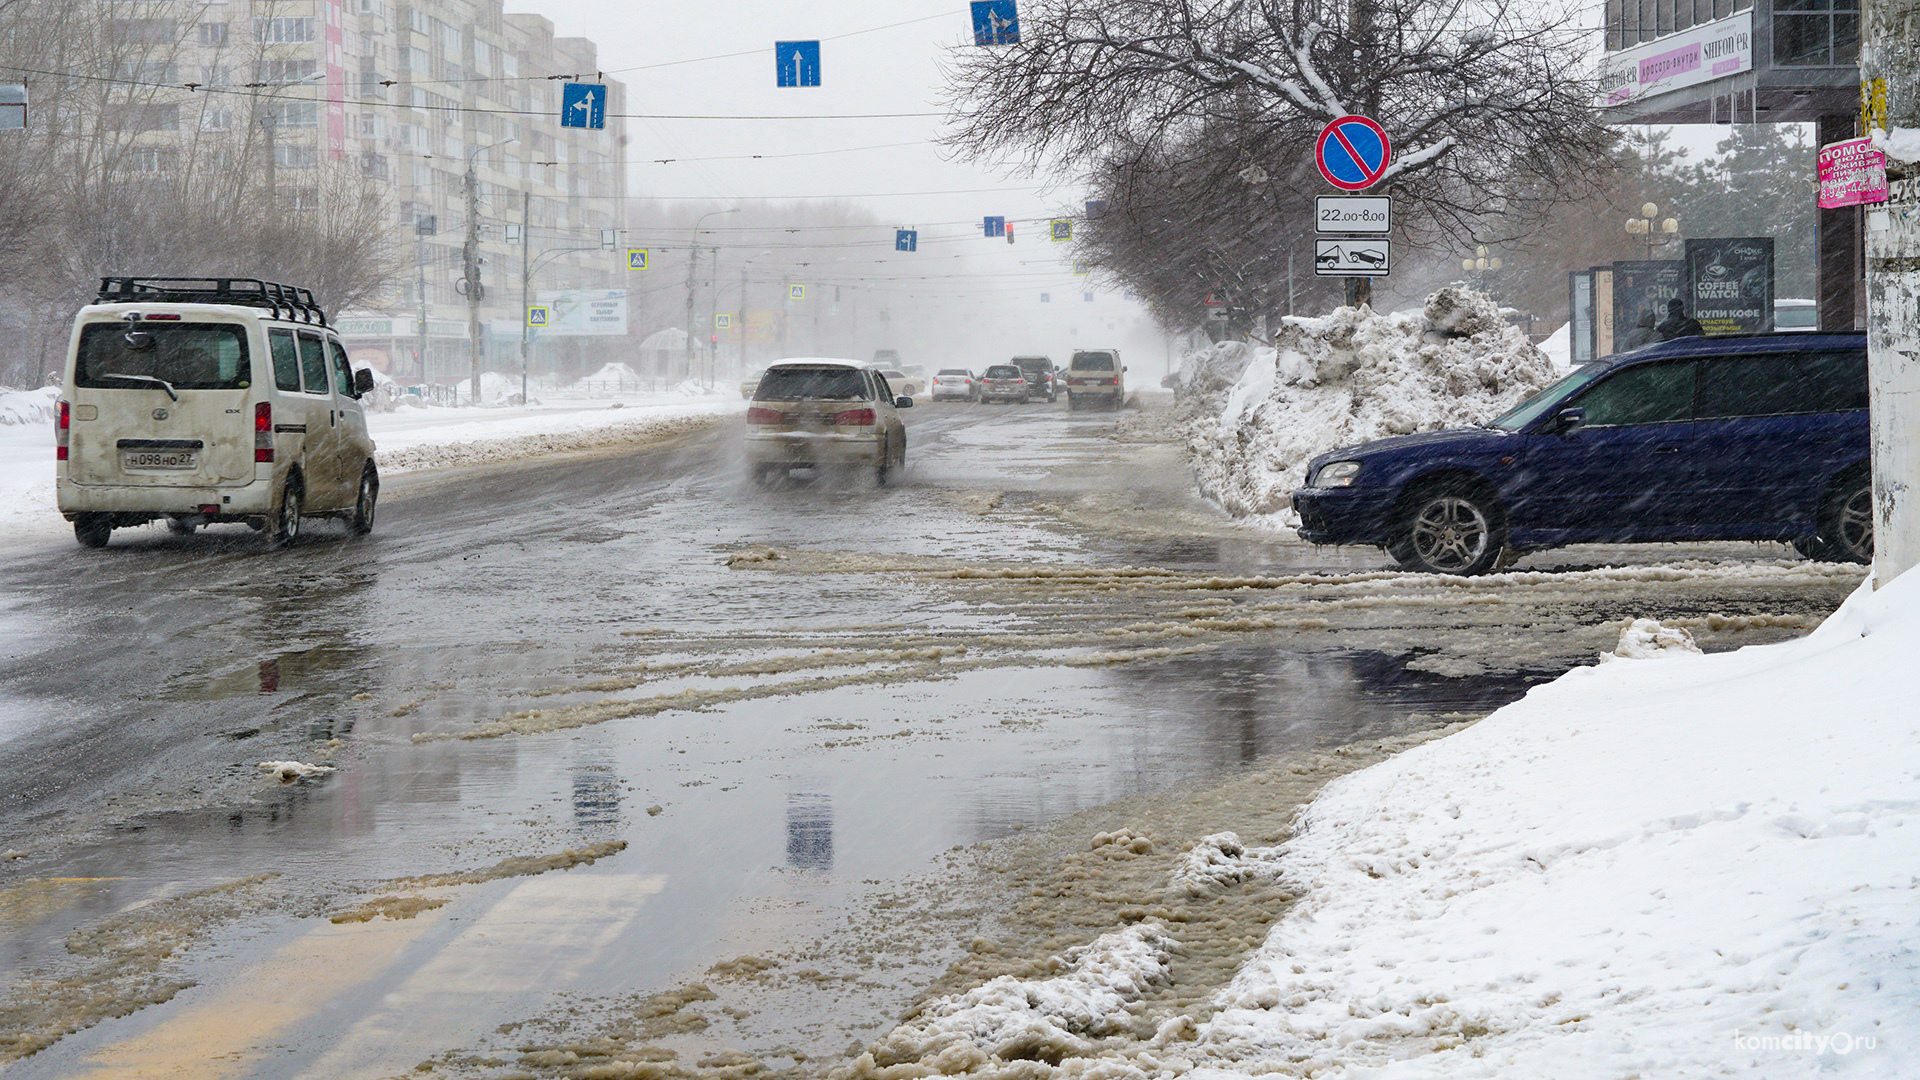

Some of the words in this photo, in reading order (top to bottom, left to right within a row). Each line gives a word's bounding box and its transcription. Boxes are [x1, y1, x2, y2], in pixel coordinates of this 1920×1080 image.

[1321, 209, 1385, 221] 22.00-8.00
[1698, 281, 1739, 290] COFFEE
[1698, 290, 1739, 298] WATCH
[1697, 310, 1727, 318] КУПИ
[1730, 309, 1760, 318] КОФЕ
[180, 454, 191, 463] 27
